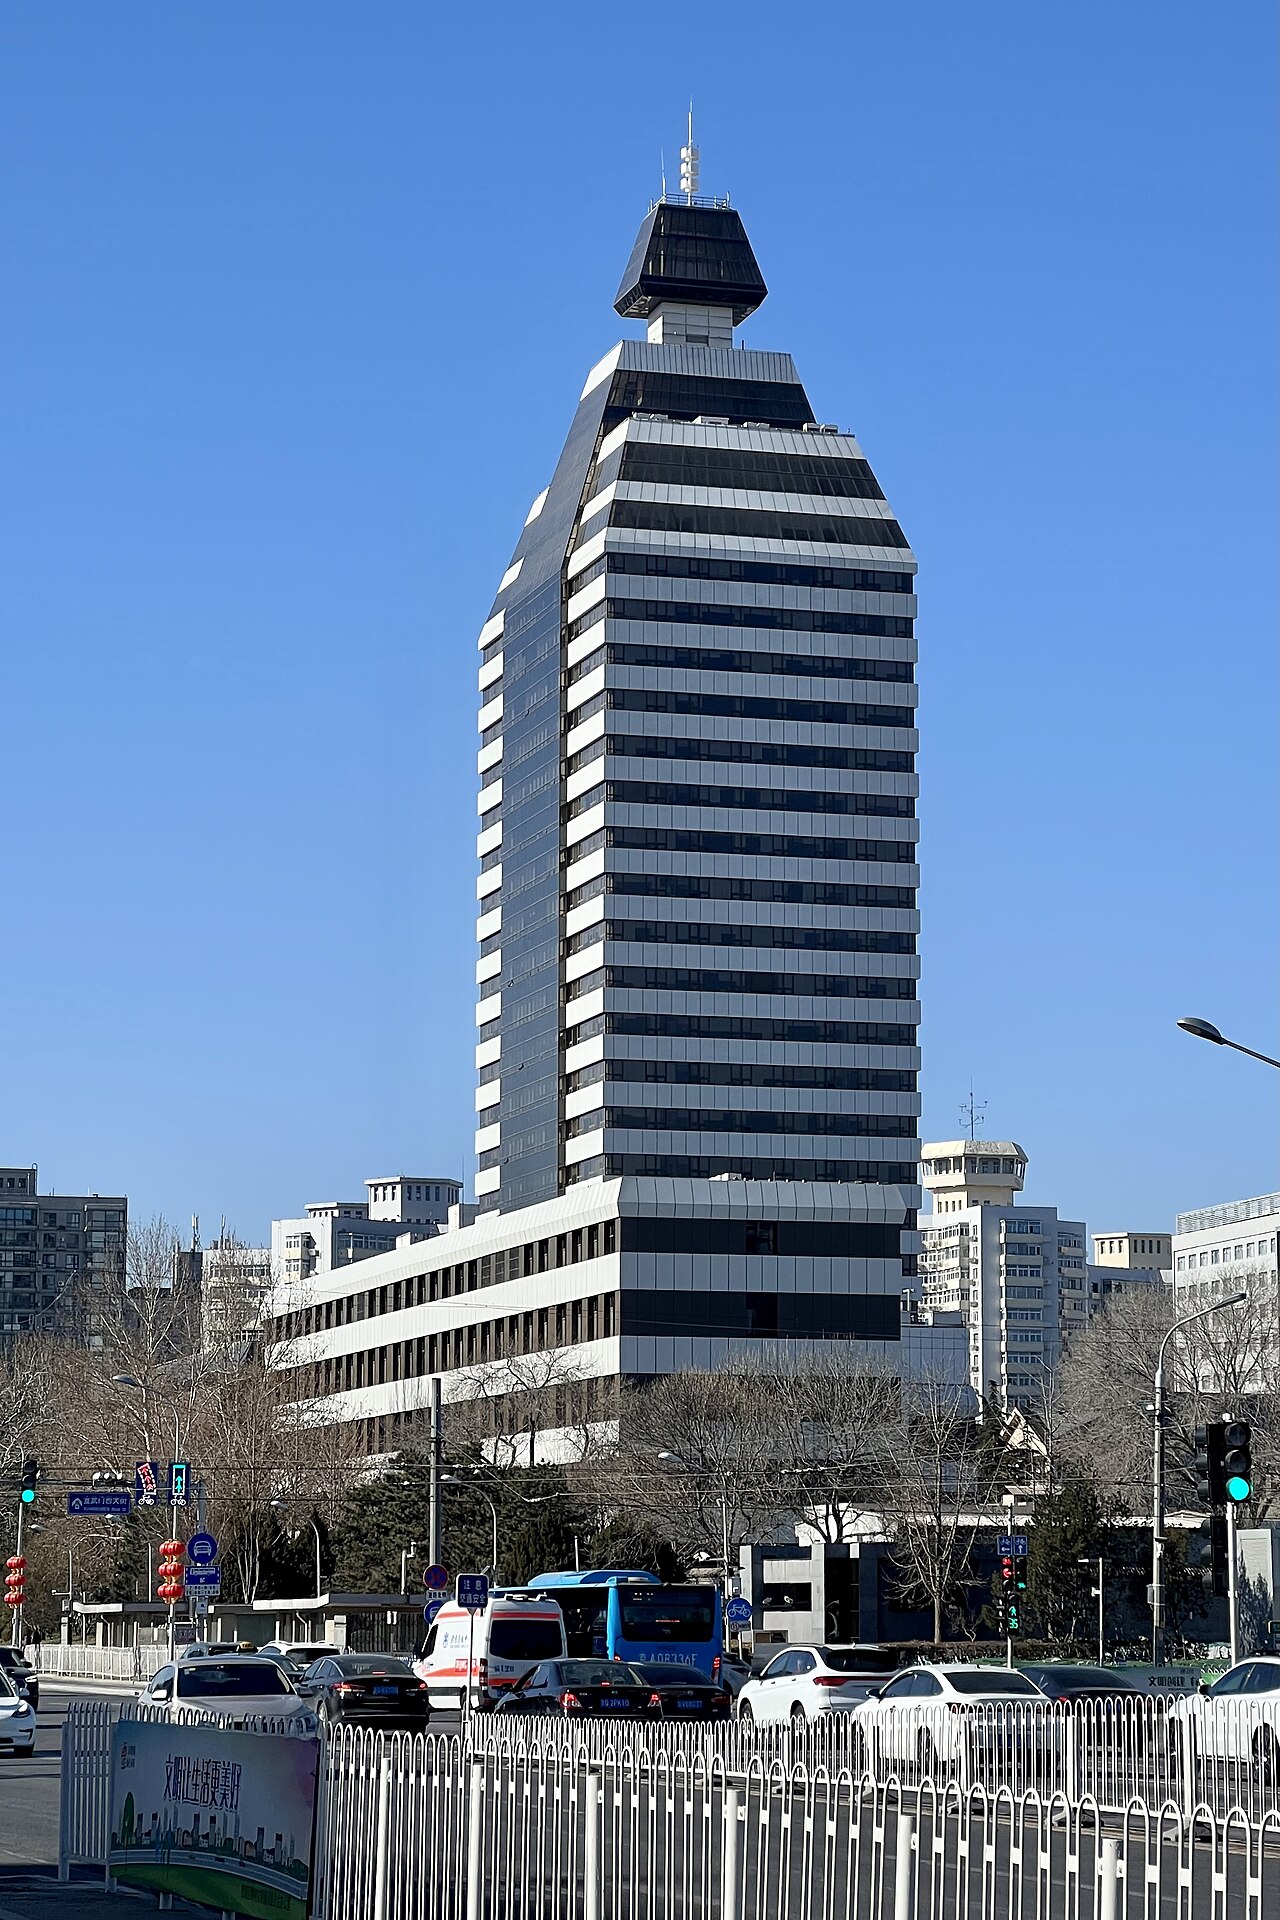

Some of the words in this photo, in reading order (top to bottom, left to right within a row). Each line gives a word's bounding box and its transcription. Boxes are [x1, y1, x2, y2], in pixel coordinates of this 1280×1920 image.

[459, 1593, 486, 1604] 交通安全
[163, 1753, 242, 1811] 文明让生活更美好
